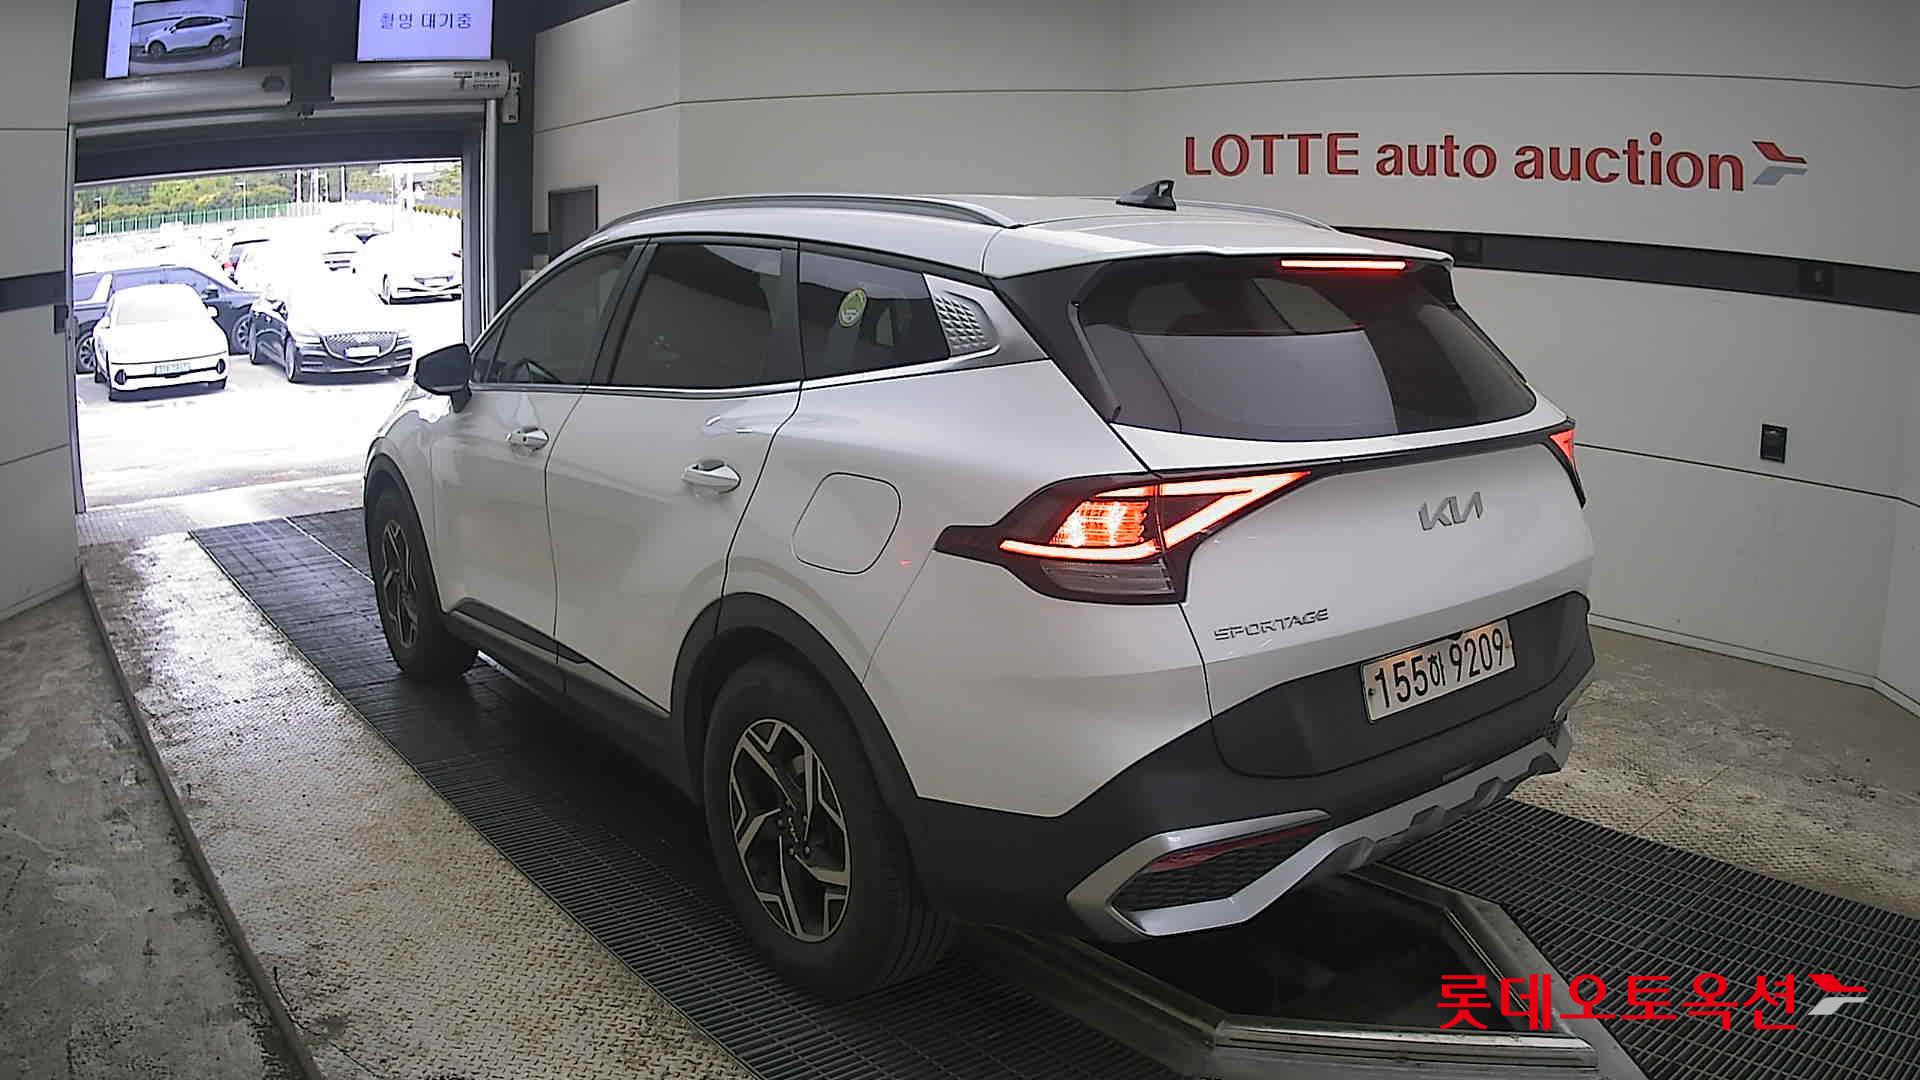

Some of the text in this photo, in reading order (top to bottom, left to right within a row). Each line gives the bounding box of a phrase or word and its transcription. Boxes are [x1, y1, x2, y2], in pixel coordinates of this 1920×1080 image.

[420, 12, 473, 30] 대기중
[1185, 132, 1745, 192] LOTTE auto auction
[1417, 491, 1484, 531] KIA
[1213, 608, 1329, 641] SPORTAGE
